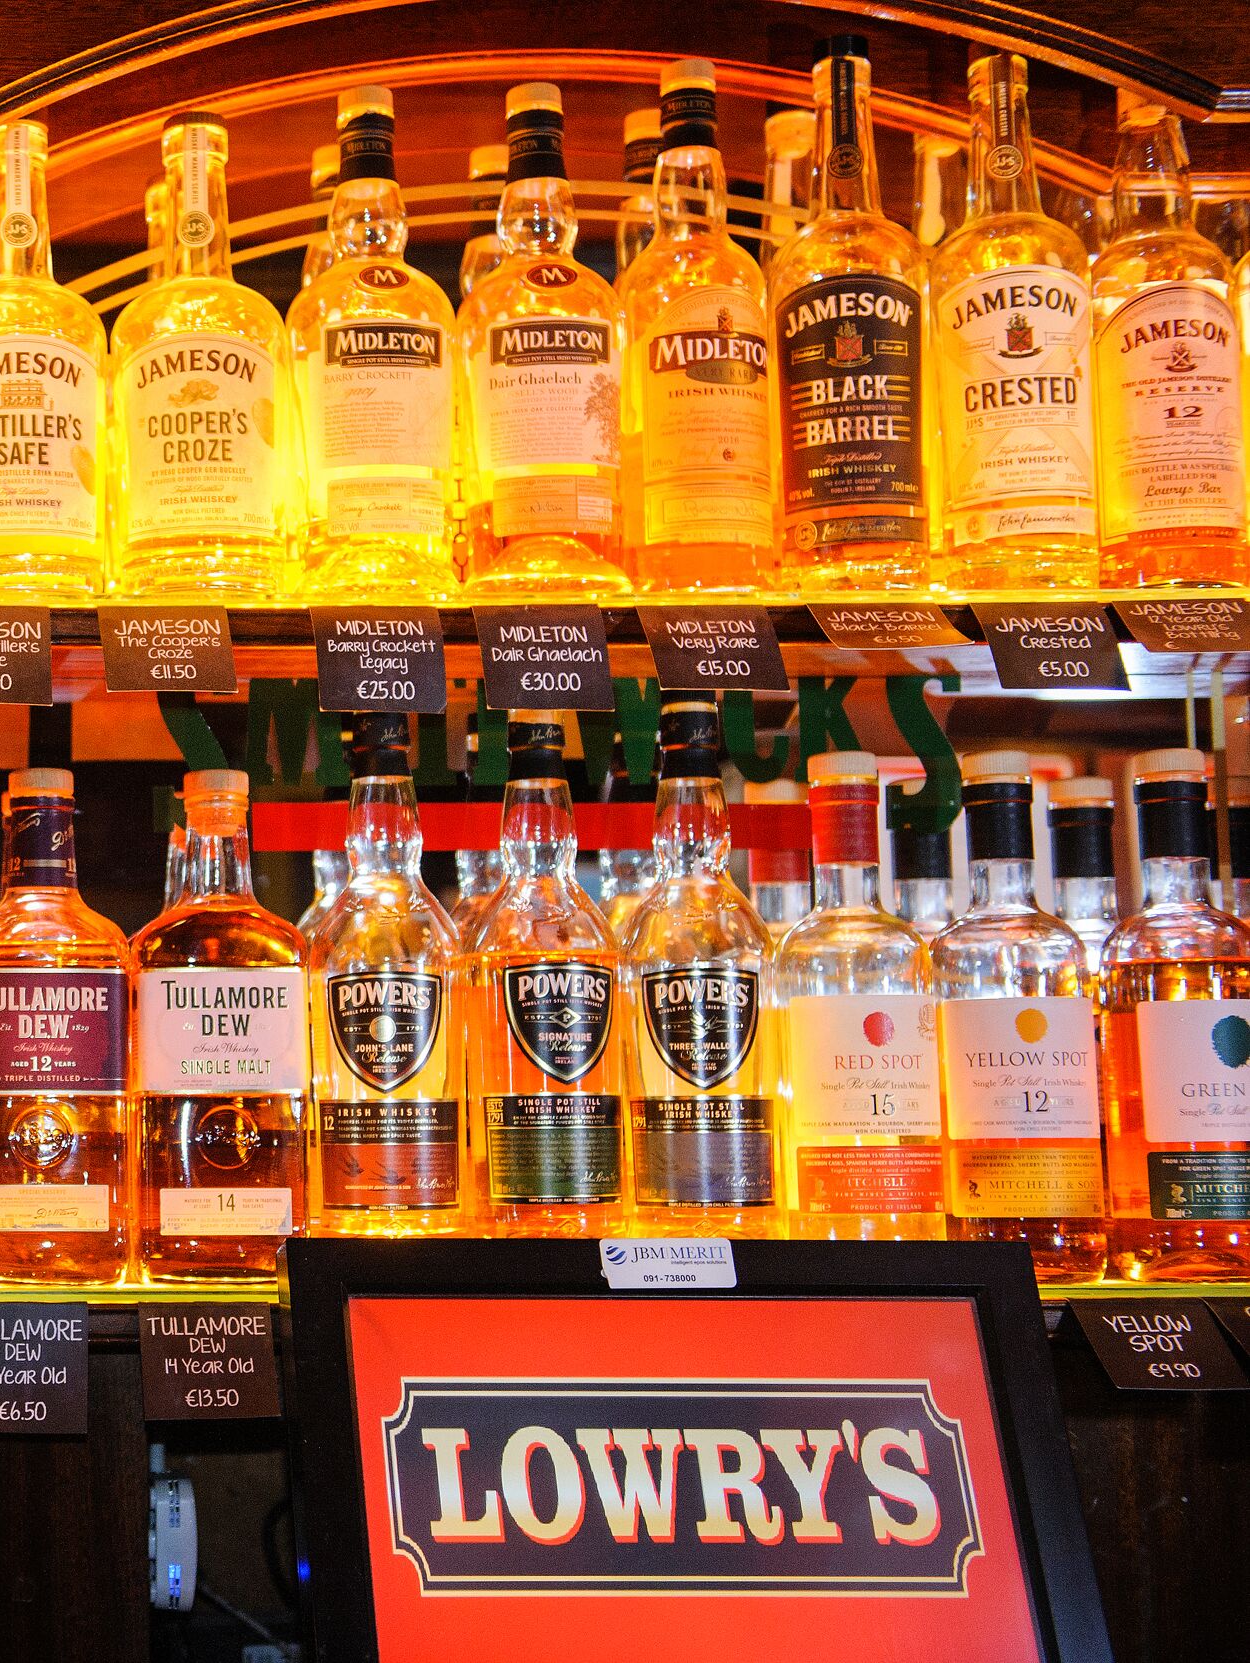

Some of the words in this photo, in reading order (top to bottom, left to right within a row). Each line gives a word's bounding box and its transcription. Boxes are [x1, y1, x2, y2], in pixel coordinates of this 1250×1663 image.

[784, 292, 910, 339] JAMESON
[952, 284, 1078, 330] JAMESON
[336, 330, 436, 357] MIDLETON
[500, 328, 603, 356] MIDLETON
[1120, 319, 1229, 354] JAMESON
[137, 349, 257, 389] JAMESON
[489, 376, 515, 390] Dair
[518, 372, 582, 387] Ghaelach
[811, 374, 888, 405] BLACK
[964, 376, 1077, 413] CRESTED
[1163, 404, 1204, 420] 12
[148, 408, 247, 438] COOPER'S
[806, 414, 899, 447] BARREL
[163, 438, 233, 463] CROZE
[808, 466, 839, 478] IRISH
[843, 463, 897, 474] WHISKEY
[1198, 482, 1221, 494] Bar
[827, 611, 936, 623] JAMESON
[1129, 602, 1243, 616] JAMESON
[114, 619, 221, 636] JAMESON
[666, 619, 755, 635] MIDLETON
[830, 622, 885, 632] Black
[886, 622, 943, 632] Barrel
[995, 616, 1106, 634] JAMESON
[1148, 614, 1160, 624] 12
[1163, 614, 1207, 624] Year
[1210, 613, 1234, 623] Old
[335, 620, 424, 637] MIDLETON
[500, 625, 588, 644] MIDLETON
[1165, 630, 1241, 641] Bottling
[117, 635, 149, 649] The
[152, 635, 221, 650] Cooper's
[327, 639, 370, 658] Barry
[372, 638, 436, 653] Crockett
[671, 635, 713, 654] Very
[716, 635, 760, 650] Rare
[874, 634, 923, 645] €6.50
[1020, 634, 1092, 650] Crested
[147, 646, 194, 660] Croze
[491, 646, 525, 663] Dair
[527, 646, 602, 666] Ghaelach
[150, 664, 197, 680] €11.50
[360, 656, 408, 674] Legacy
[696, 660, 751, 677] €15.00
[1038, 661, 1090, 678] €5.00
[356, 680, 416, 701] €25.00
[520, 672, 582, 692] €30.00
[161, 980, 288, 1010] TULLAMORE
[338, 981, 430, 1011] POWERS
[518, 972, 607, 1002] POWERS
[654, 978, 749, 1008] POWERS
[18, 1015, 70, 1040] D.E.W.
[201, 1014, 250, 1037] DEW
[538, 1032, 592, 1042] SIGNATURE
[30, 1056, 51, 1072] 12
[181, 1060, 230, 1075] SINGLE
[238, 1059, 271, 1075] MALT
[834, 1054, 874, 1070] RED
[881, 1054, 921, 1070] SPOT
[965, 1053, 1045, 1068] YELLOW
[1052, 1052, 1088, 1066] SPOT
[1181, 1083, 1246, 1097] GREEN
[870, 1093, 896, 1117] 15
[1022, 1090, 1049, 1113] 12
[217, 1193, 236, 1212] 14
[146, 1316, 267, 1336] TULLAMORE
[1103, 1315, 1192, 1333] YELLOW
[189, 1337, 226, 1354] DEW
[1129, 1334, 1184, 1352] SPOT
[5, 1343, 41, 1362] DEW
[40, 1366, 67, 1384] Old
[164, 1358, 177, 1374] 14
[180, 1358, 220, 1375] Year
[224, 1357, 254, 1374] Old
[1148, 1364, 1201, 1378] €9.90
[185, 1388, 240, 1407] €13.50
[422, 1419, 942, 1546] LOWRY'S
